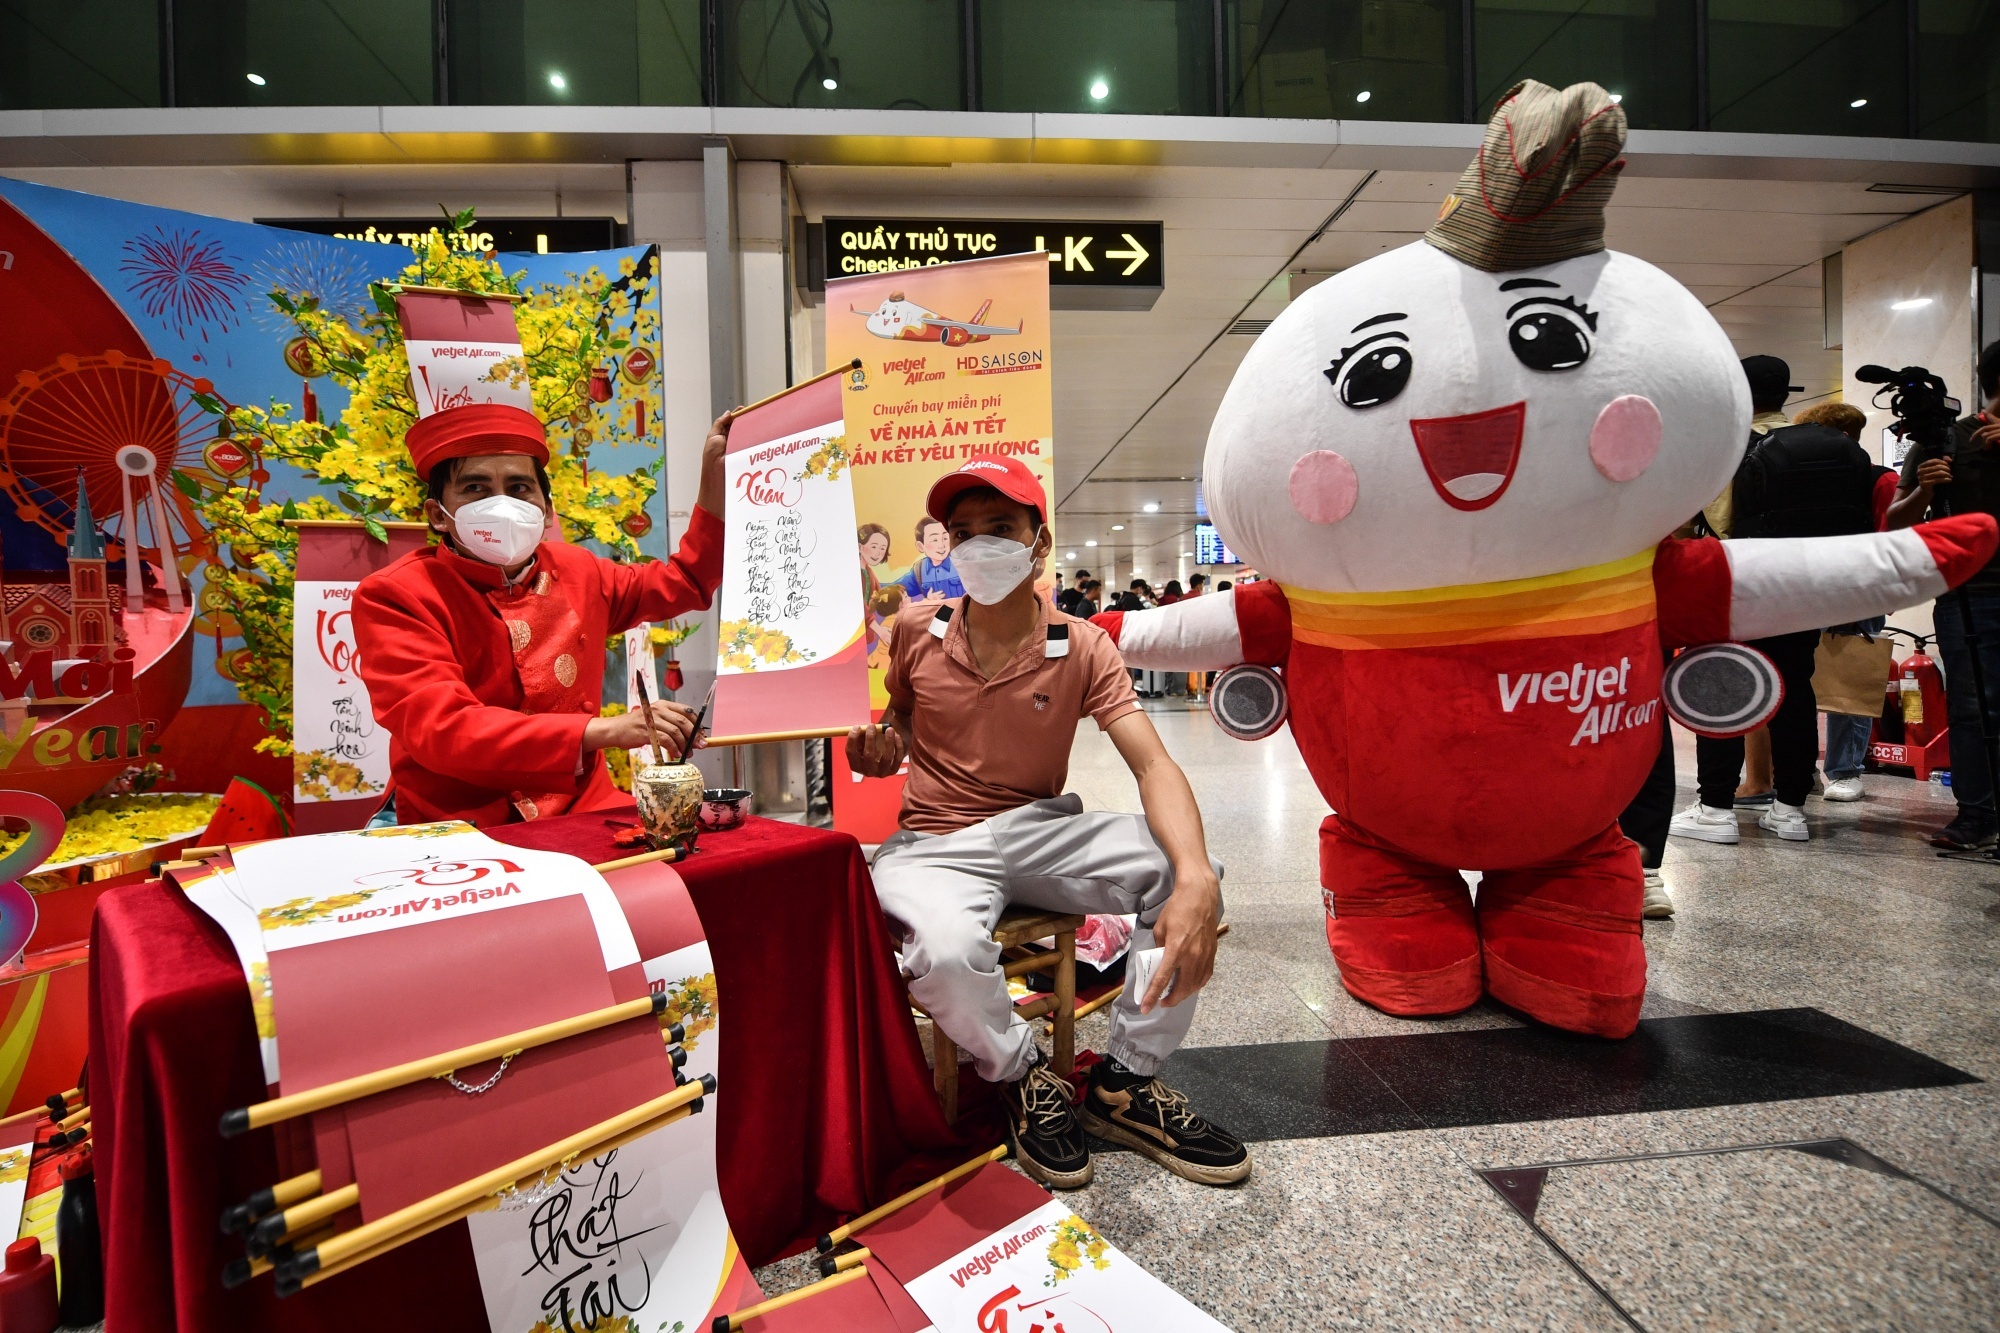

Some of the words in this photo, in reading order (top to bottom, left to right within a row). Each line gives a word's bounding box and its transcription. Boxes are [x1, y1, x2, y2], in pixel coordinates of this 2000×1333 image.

[841, 225, 900, 250] QUẦY
[905, 227, 948, 251] THỦ
[953, 233, 997, 254] TỤC
[841, 256, 921, 273] Check-In
[957, 356, 979, 370] HD
[981, 349, 1042, 369] SAISON
[873, 399, 919, 417] Chuyến
[921, 400, 944, 413] bay
[947, 394, 978, 410] miễn
[981, 394, 1002, 410] phí
[870, 420, 893, 442] VỀ
[897, 420, 938, 440] NHÀ
[941, 418, 969, 438] ĂN
[973, 412, 1007, 434] TẾT
[848, 443, 877, 468] ẮN
[881, 441, 916, 464] KẾT
[920, 443, 955, 462] YÊU
[959, 439, 1040, 459] THƯƠNG
[0, 716, 155, 770] Year
